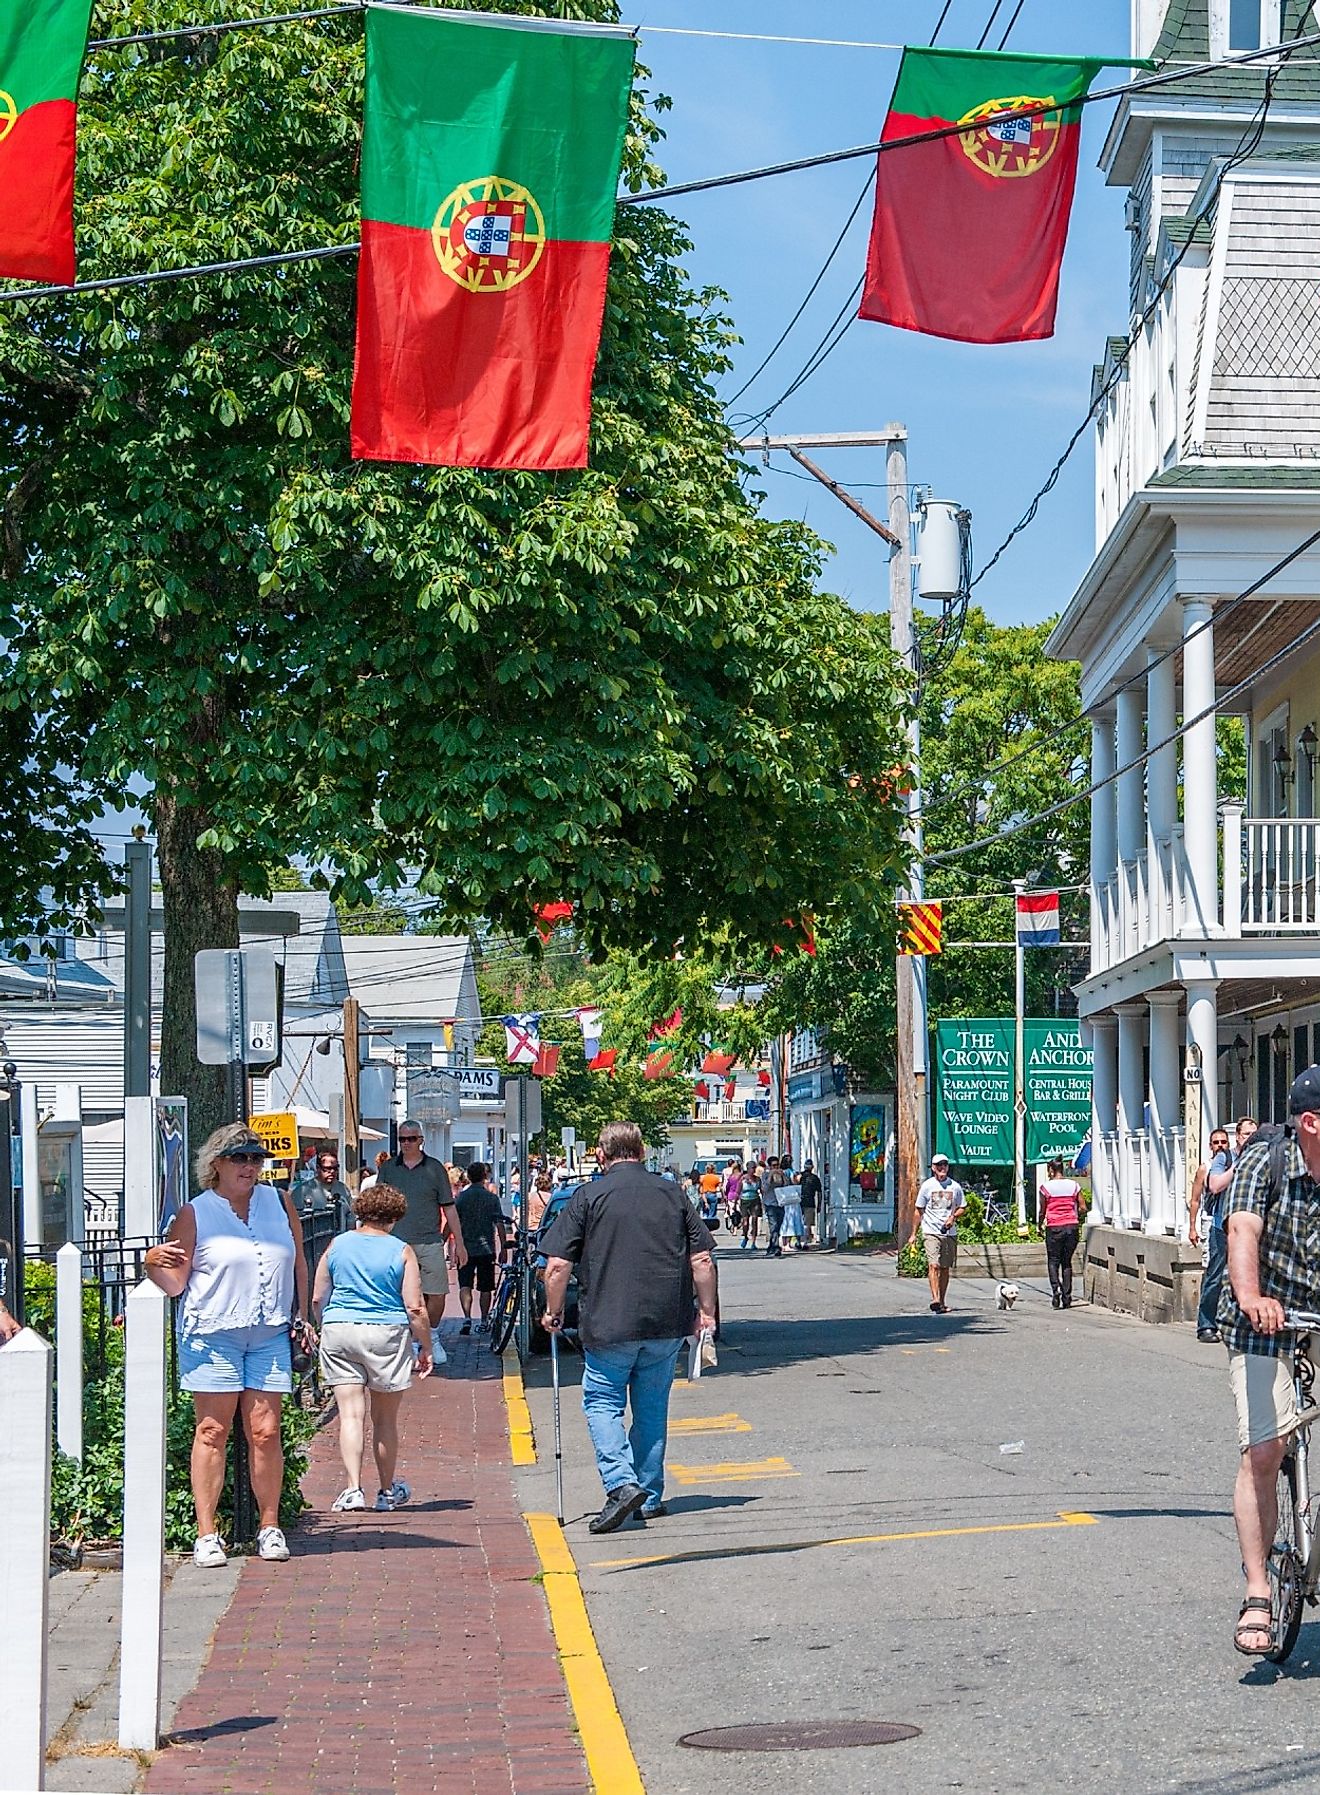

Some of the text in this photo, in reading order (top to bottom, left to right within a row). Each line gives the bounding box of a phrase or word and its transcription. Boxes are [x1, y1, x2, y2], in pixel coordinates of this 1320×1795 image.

[957, 1031, 995, 1049] THE
[1043, 1030, 1082, 1049] AND
[942, 1049, 1009, 1066] CROWN
[1028, 1050, 1094, 1066] ANCHOR
[454, 1071, 493, 1087] DAMS
[1186, 1068, 1200, 1080] NO
[943, 1078, 1009, 1090] PARAMOUNT
[1029, 1078, 1092, 1089] CENTRAL HOUS
[943, 1090, 1009, 1102] NIGHT CLUB
[1034, 1090, 1052, 1101] BAR
[1053, 1091, 1060, 1100] &
[943, 1111, 1009, 1123] WAVE VIDEO
[954, 1122, 998, 1134] LOUNGE
[1049, 1122, 1077, 1134] POOL
[960, 1144, 992, 1156] VAULT
